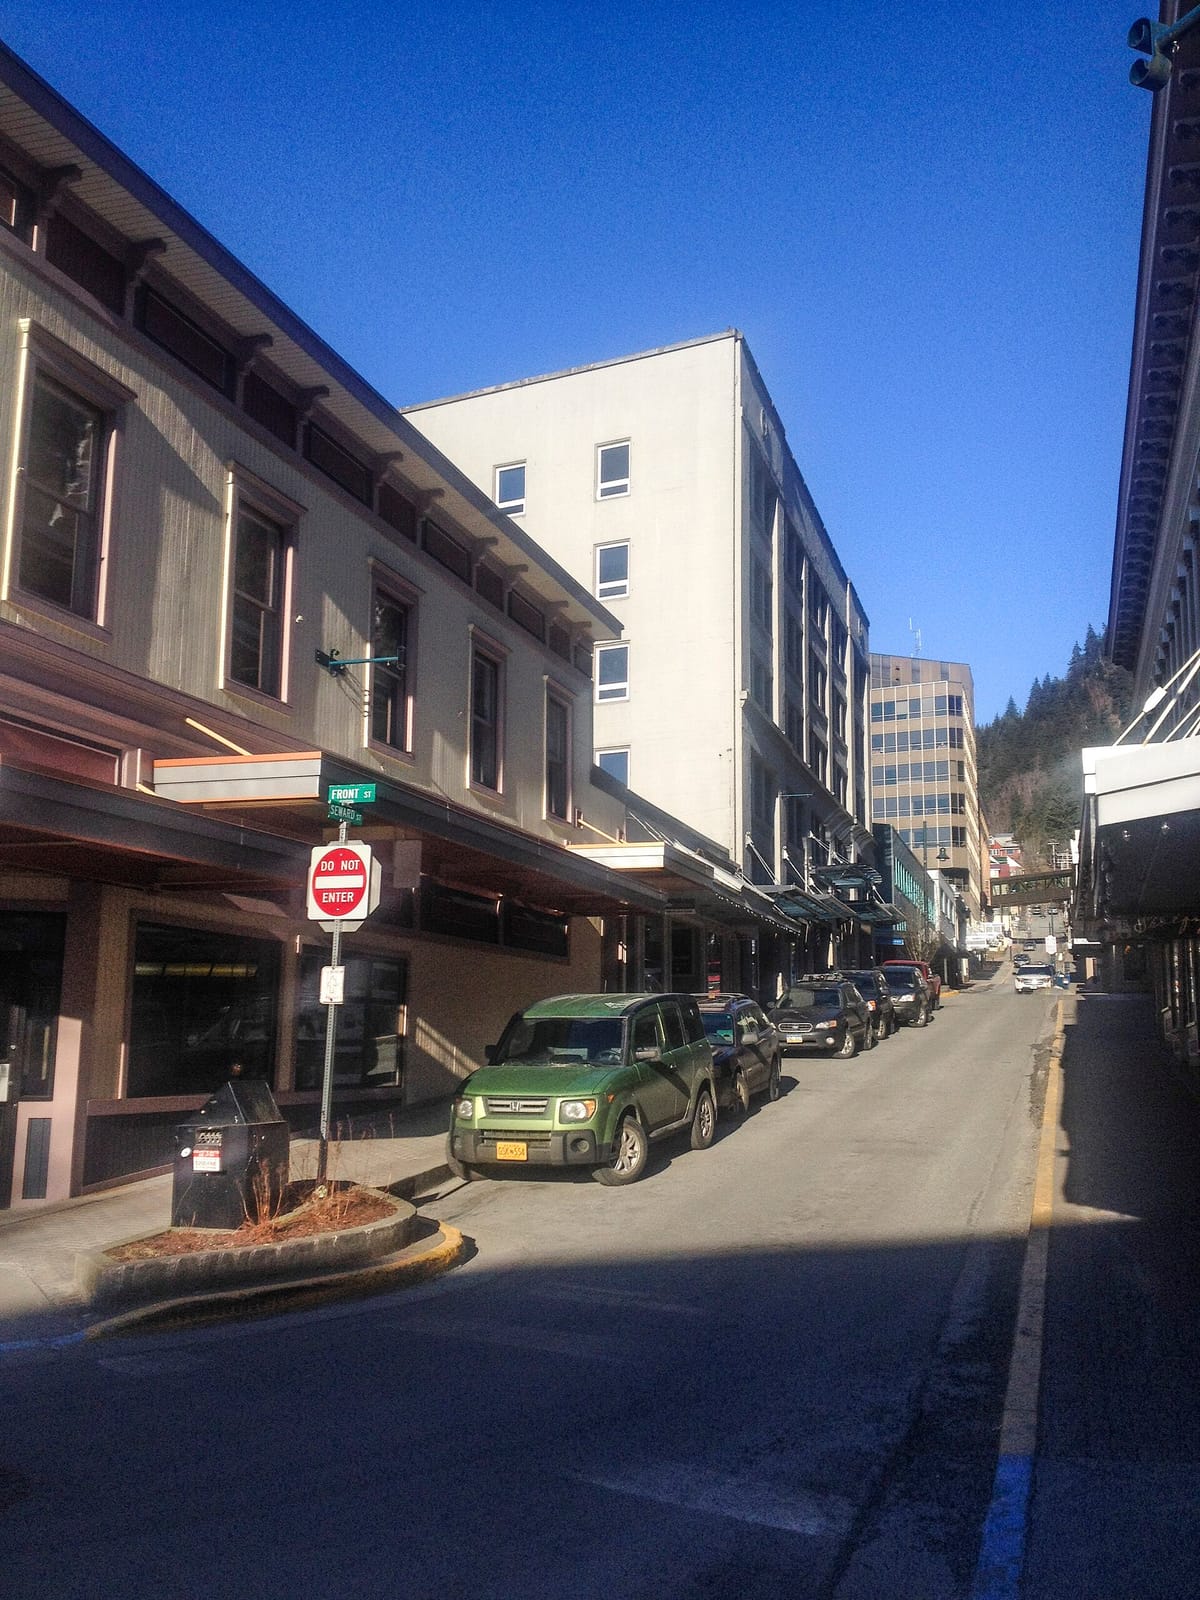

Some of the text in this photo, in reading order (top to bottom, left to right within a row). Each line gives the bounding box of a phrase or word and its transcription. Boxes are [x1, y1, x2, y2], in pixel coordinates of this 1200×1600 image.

[331, 788, 372, 800] FRONT ST
[330, 804, 356, 820] SEWARD
[320, 859, 361, 872] DO NOT
[322, 891, 354, 903] ENTER
